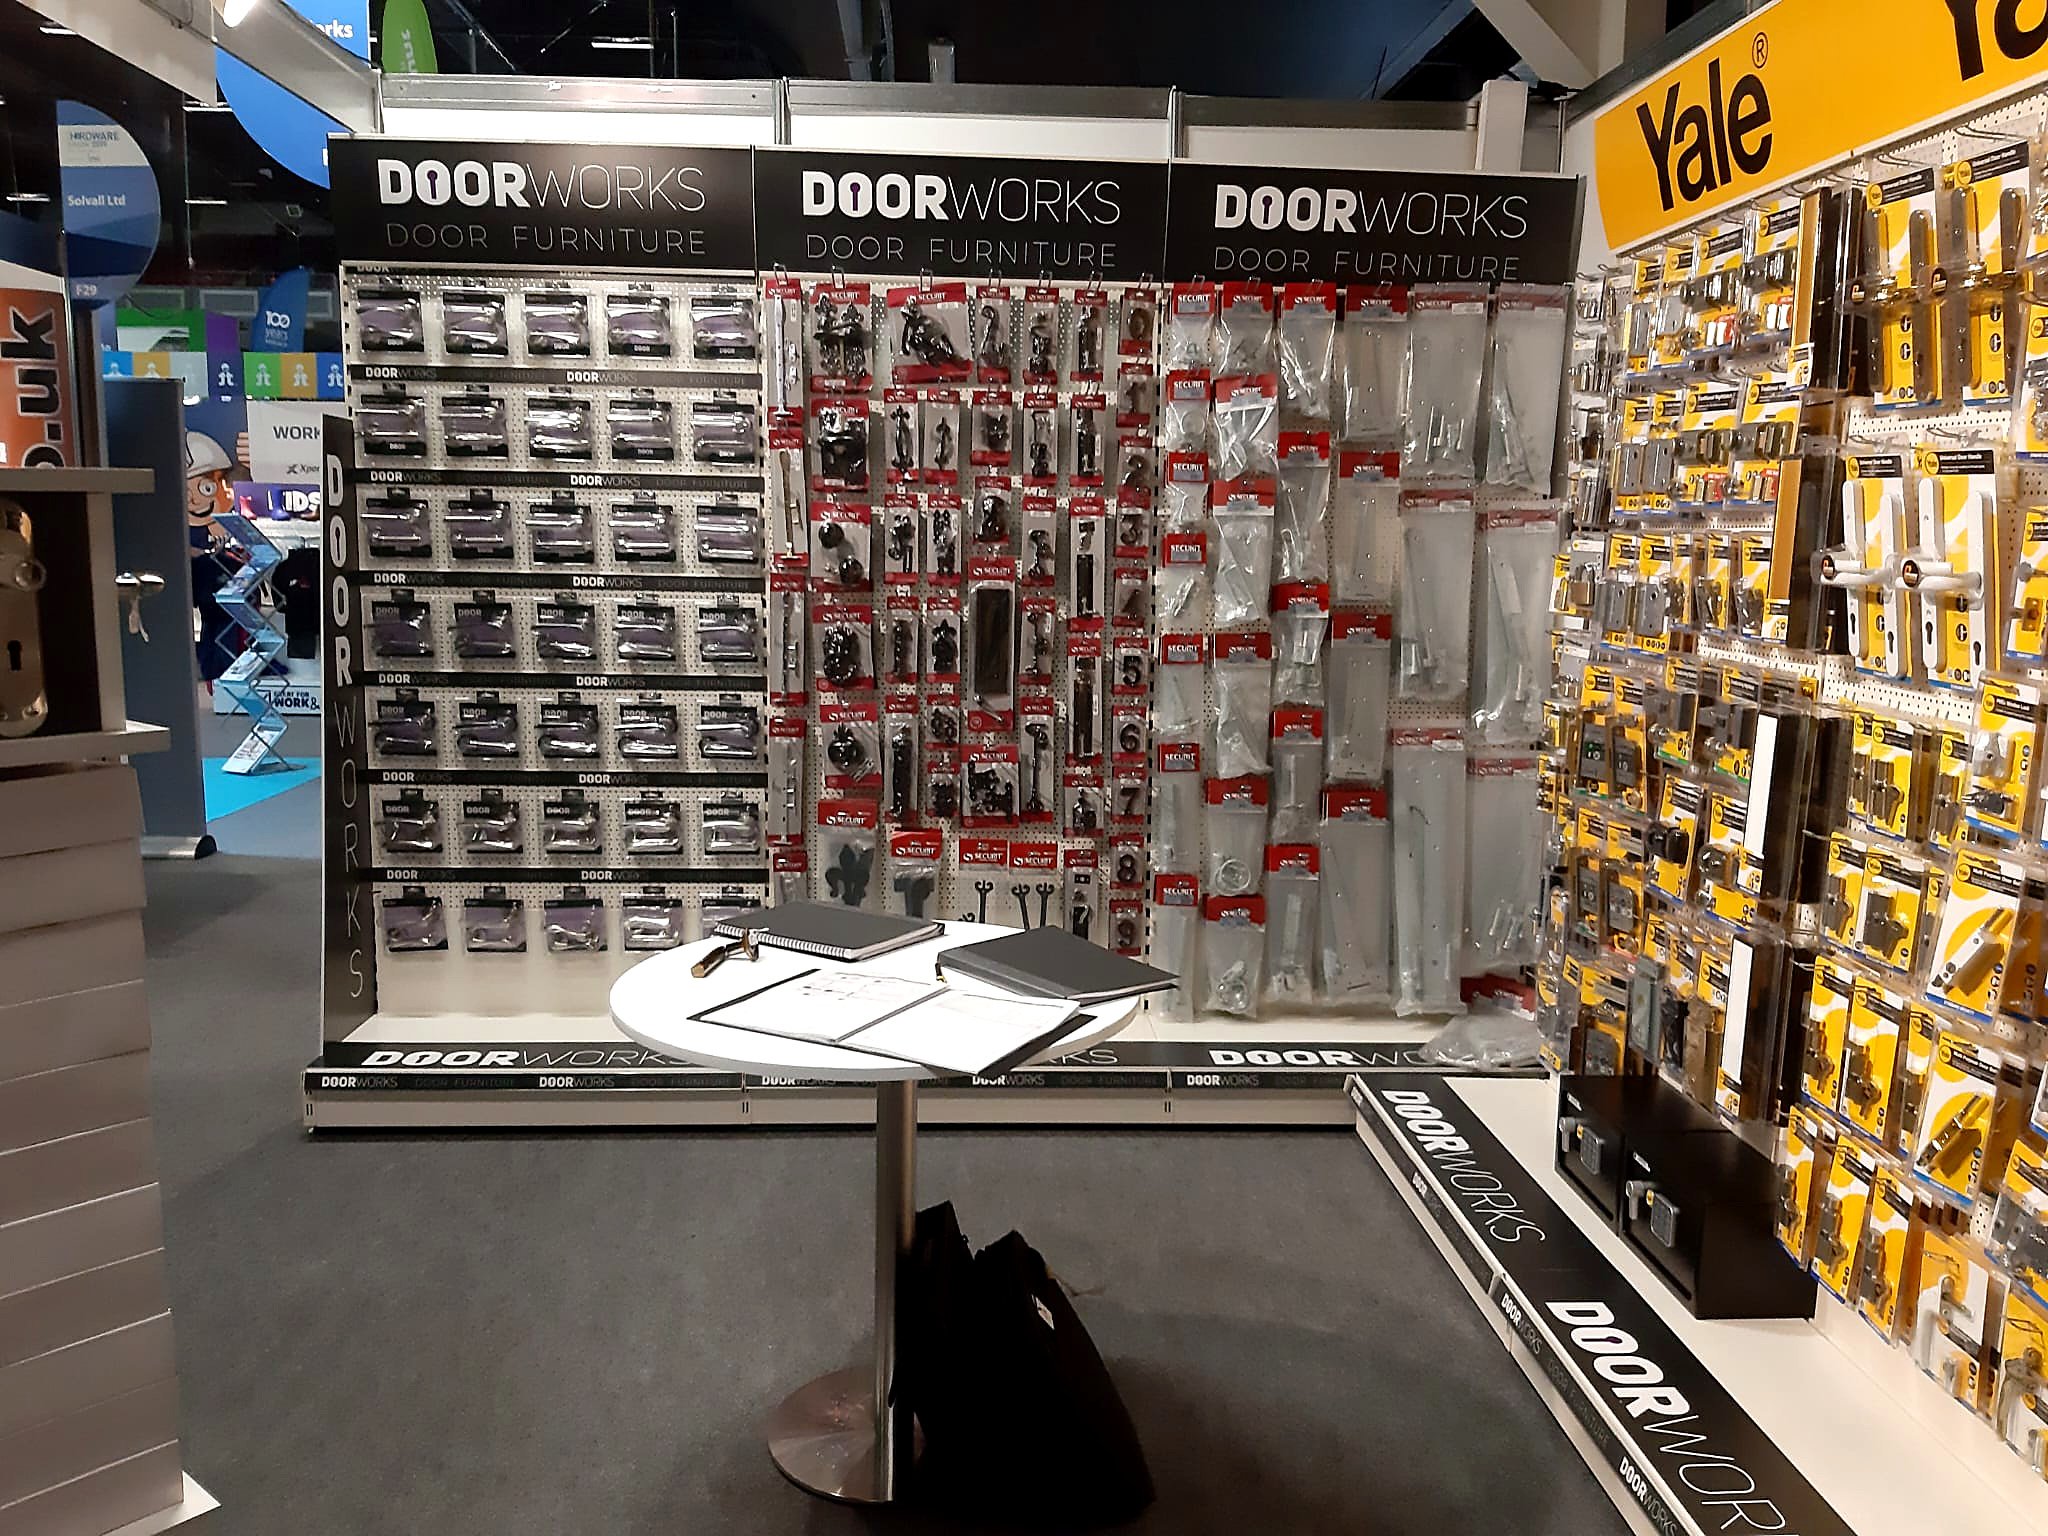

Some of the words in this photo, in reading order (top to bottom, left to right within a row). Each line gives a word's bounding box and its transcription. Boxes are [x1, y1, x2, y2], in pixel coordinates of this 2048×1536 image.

[1636, 57, 1773, 212] Yale
[377, 159, 705, 211] DOORWORKS
[107, 195, 126, 205] Ltd
[802, 170, 1120, 224] DOORWORKS
[1214, 184, 1528, 238] DOORWORKS
[386, 223, 488, 249] DOOR
[513, 226, 705, 254] FURNITURE
[806, 235, 903, 260] DOOR
[931, 238, 1116, 267] FURNITURE
[1214, 247, 1310, 273] DOOR
[1335, 250, 1519, 280] FURNITURE
[76, 285, 96, 296] F29
[266, 311, 290, 323] 100
[567, 371, 637, 384] DOORWORKS
[1173, 463, 1204, 471] SECURIT
[571, 475, 640, 487] DOORWORKS
[268, 490, 320, 512] IDS
[984, 567, 1010, 575] SECURIT
[573, 577, 642, 588] DOORWORKS
[1123, 656, 1140, 685] 5
[576, 676, 645, 687] DOORWORKS
[274, 698, 309, 708] WORK
[1120, 723, 1140, 751] 6
[981, 752, 1007, 760] SECURIT
[1120, 787, 1140, 815] 7
[908, 847, 935, 855] SECURIT
[974, 853, 1002, 861] SECURIT
[1026, 857, 1053, 865] SECURIT
[1117, 854, 1136, 882] 8
[1163, 888, 1194, 896] SECURIT
[1209, 1050, 1434, 1066] DOORWO
[321, 1076, 397, 1089] DOORWORKS
[539, 1076, 614, 1089] DOORWORKS
[1187, 1075, 1259, 1087] DOORWORKS
[1381, 1090, 1546, 1242] DOORWORKS
[1501, 1293, 1542, 1355] DOORWORKS
